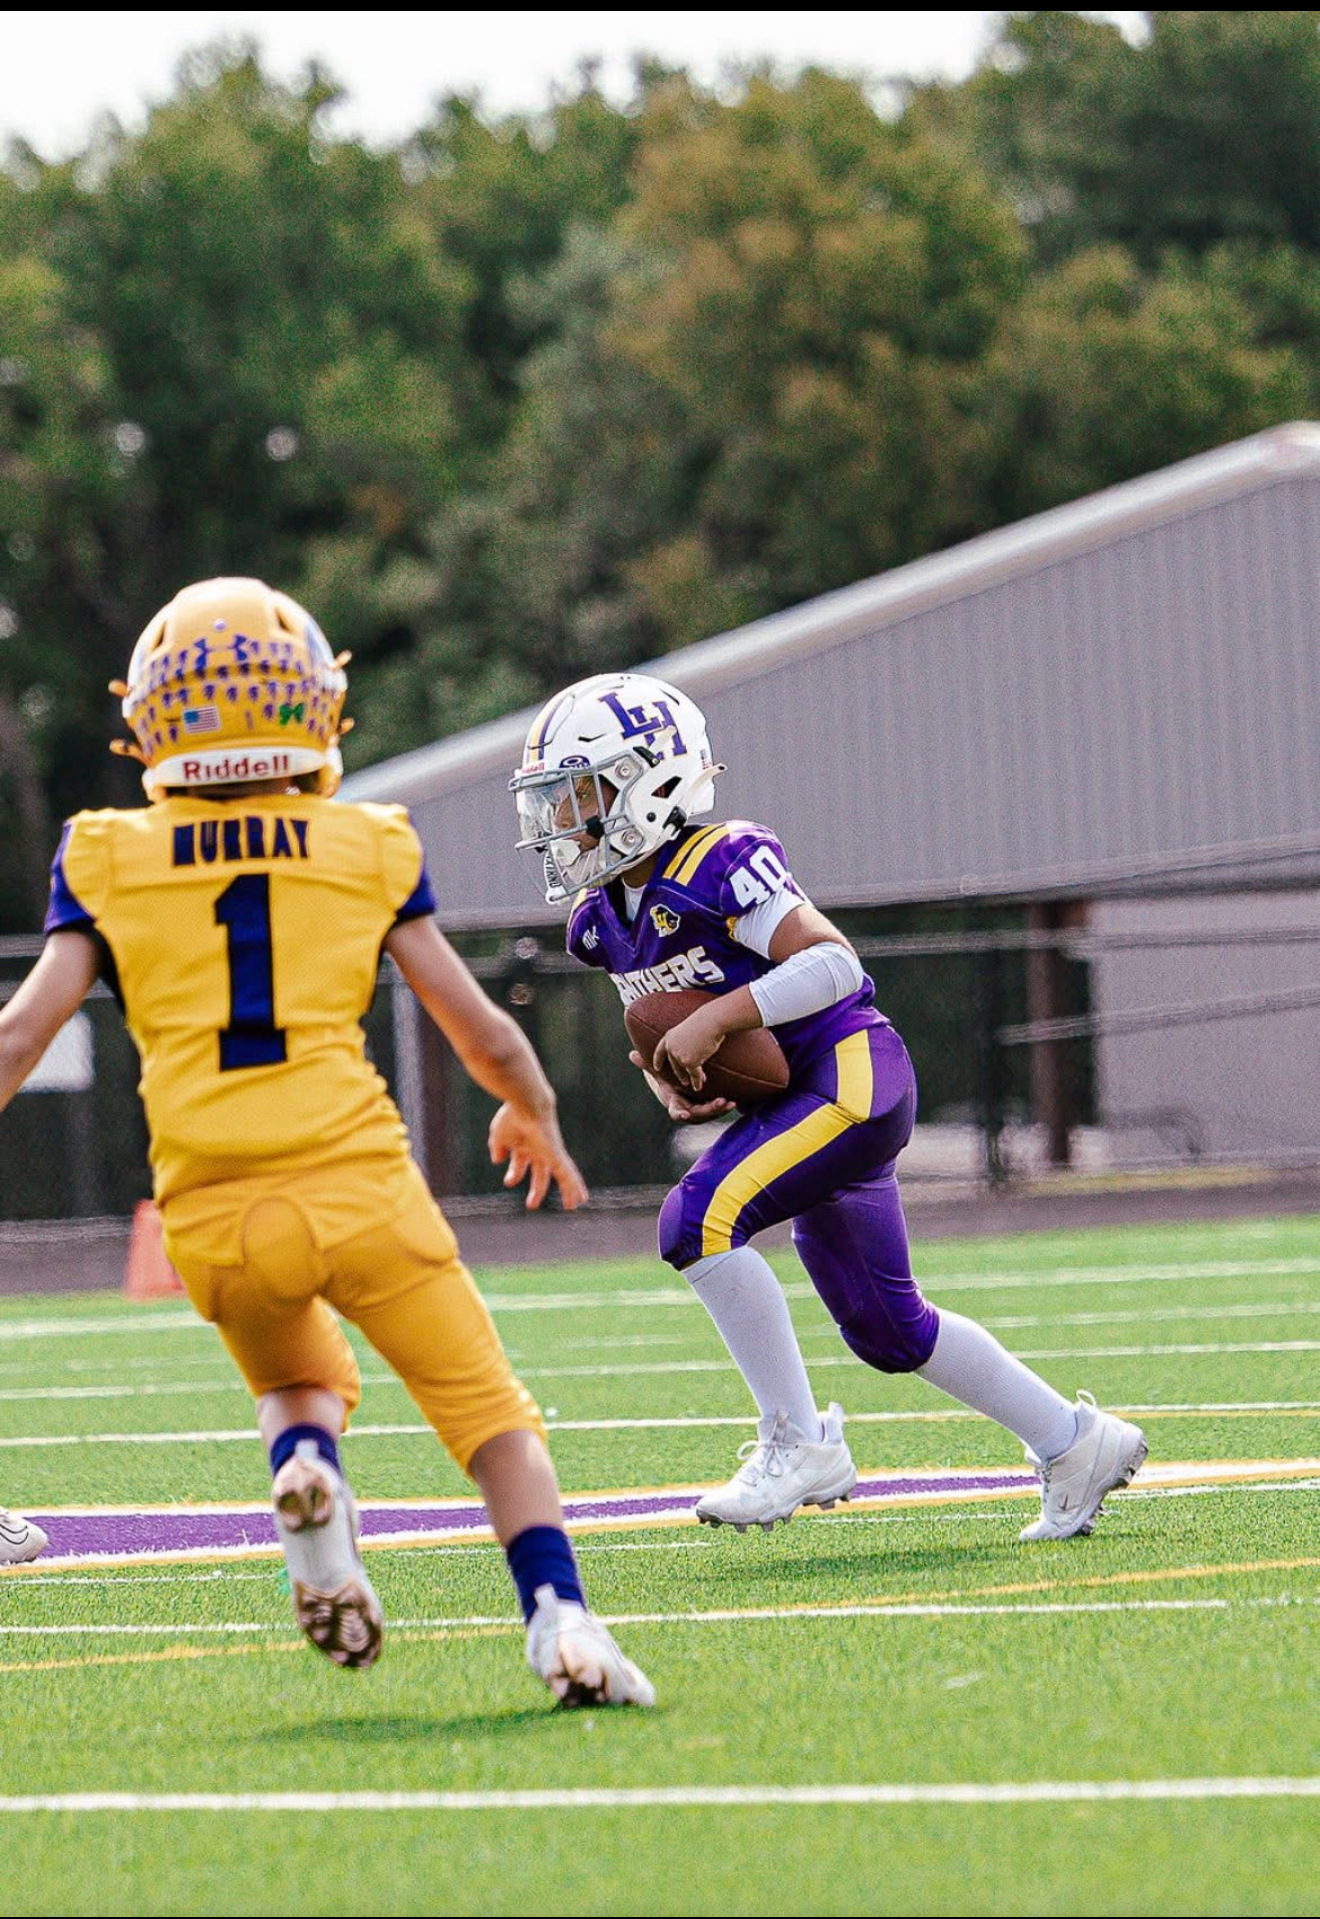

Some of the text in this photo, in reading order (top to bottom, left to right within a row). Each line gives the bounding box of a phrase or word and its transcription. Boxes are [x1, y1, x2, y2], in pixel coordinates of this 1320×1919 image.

[183, 755, 288, 779] Riddell
[730, 845, 788, 908] 40
[214, 873, 287, 1072] 1
